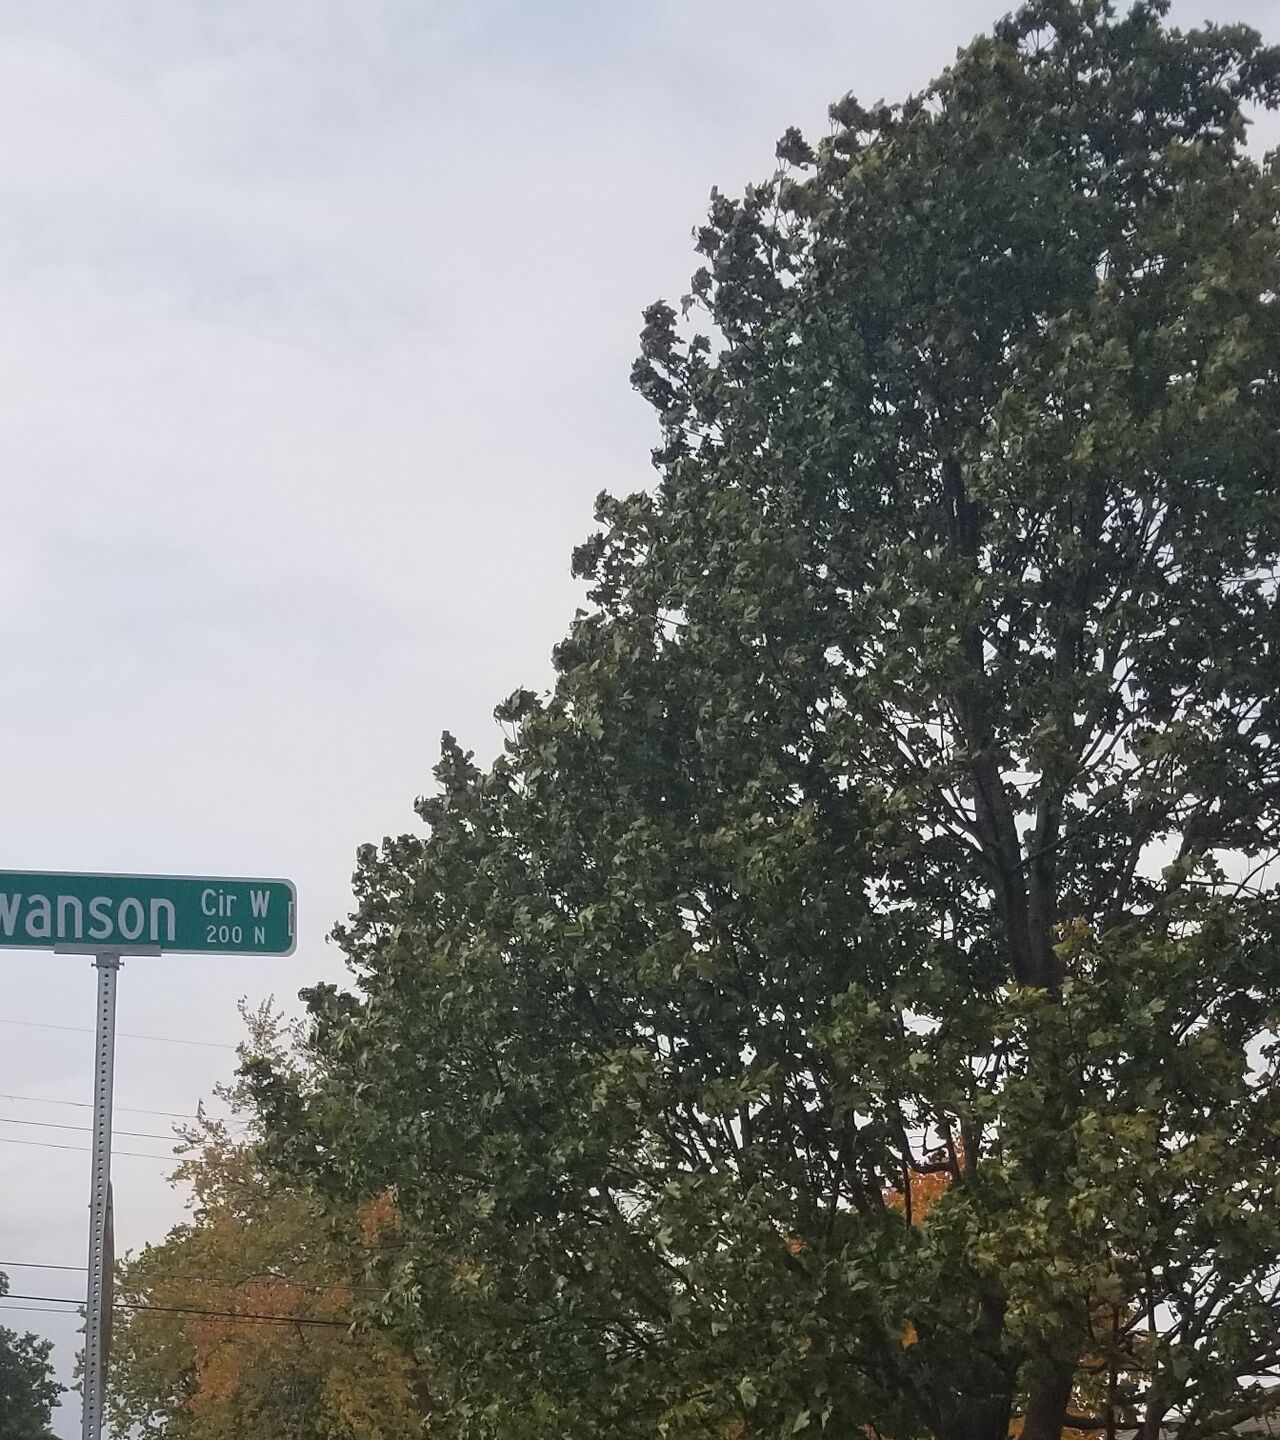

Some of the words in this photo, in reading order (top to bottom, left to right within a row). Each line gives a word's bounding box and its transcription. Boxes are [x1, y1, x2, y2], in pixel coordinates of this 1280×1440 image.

[201, 888, 237, 917] Cir
[250, 890, 271, 918] W
[206, 925, 242, 944] 200
[254, 926, 265, 945] N
